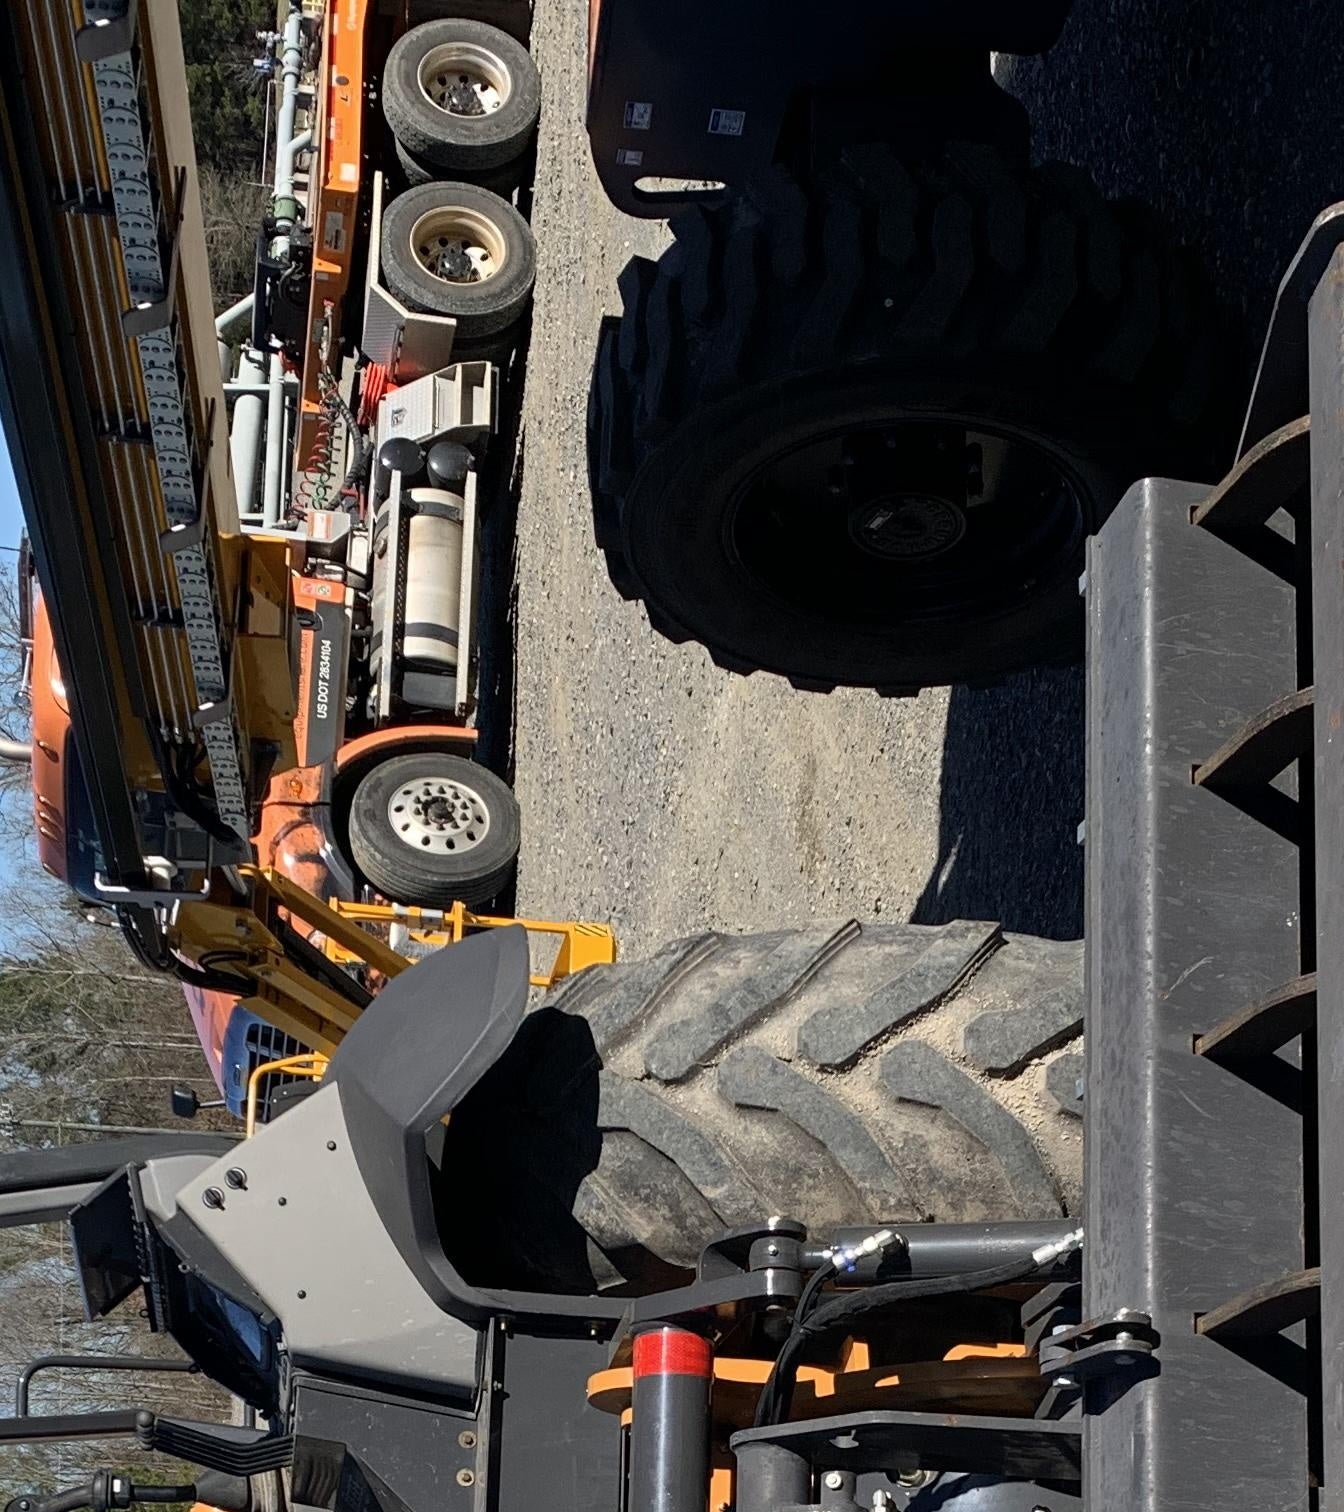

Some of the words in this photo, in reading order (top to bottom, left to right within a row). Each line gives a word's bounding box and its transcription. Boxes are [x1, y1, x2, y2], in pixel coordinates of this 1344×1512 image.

[319, 640, 331, 679] 2834104
[318, 680, 328, 702] DOT
[317, 704, 327, 718] US
